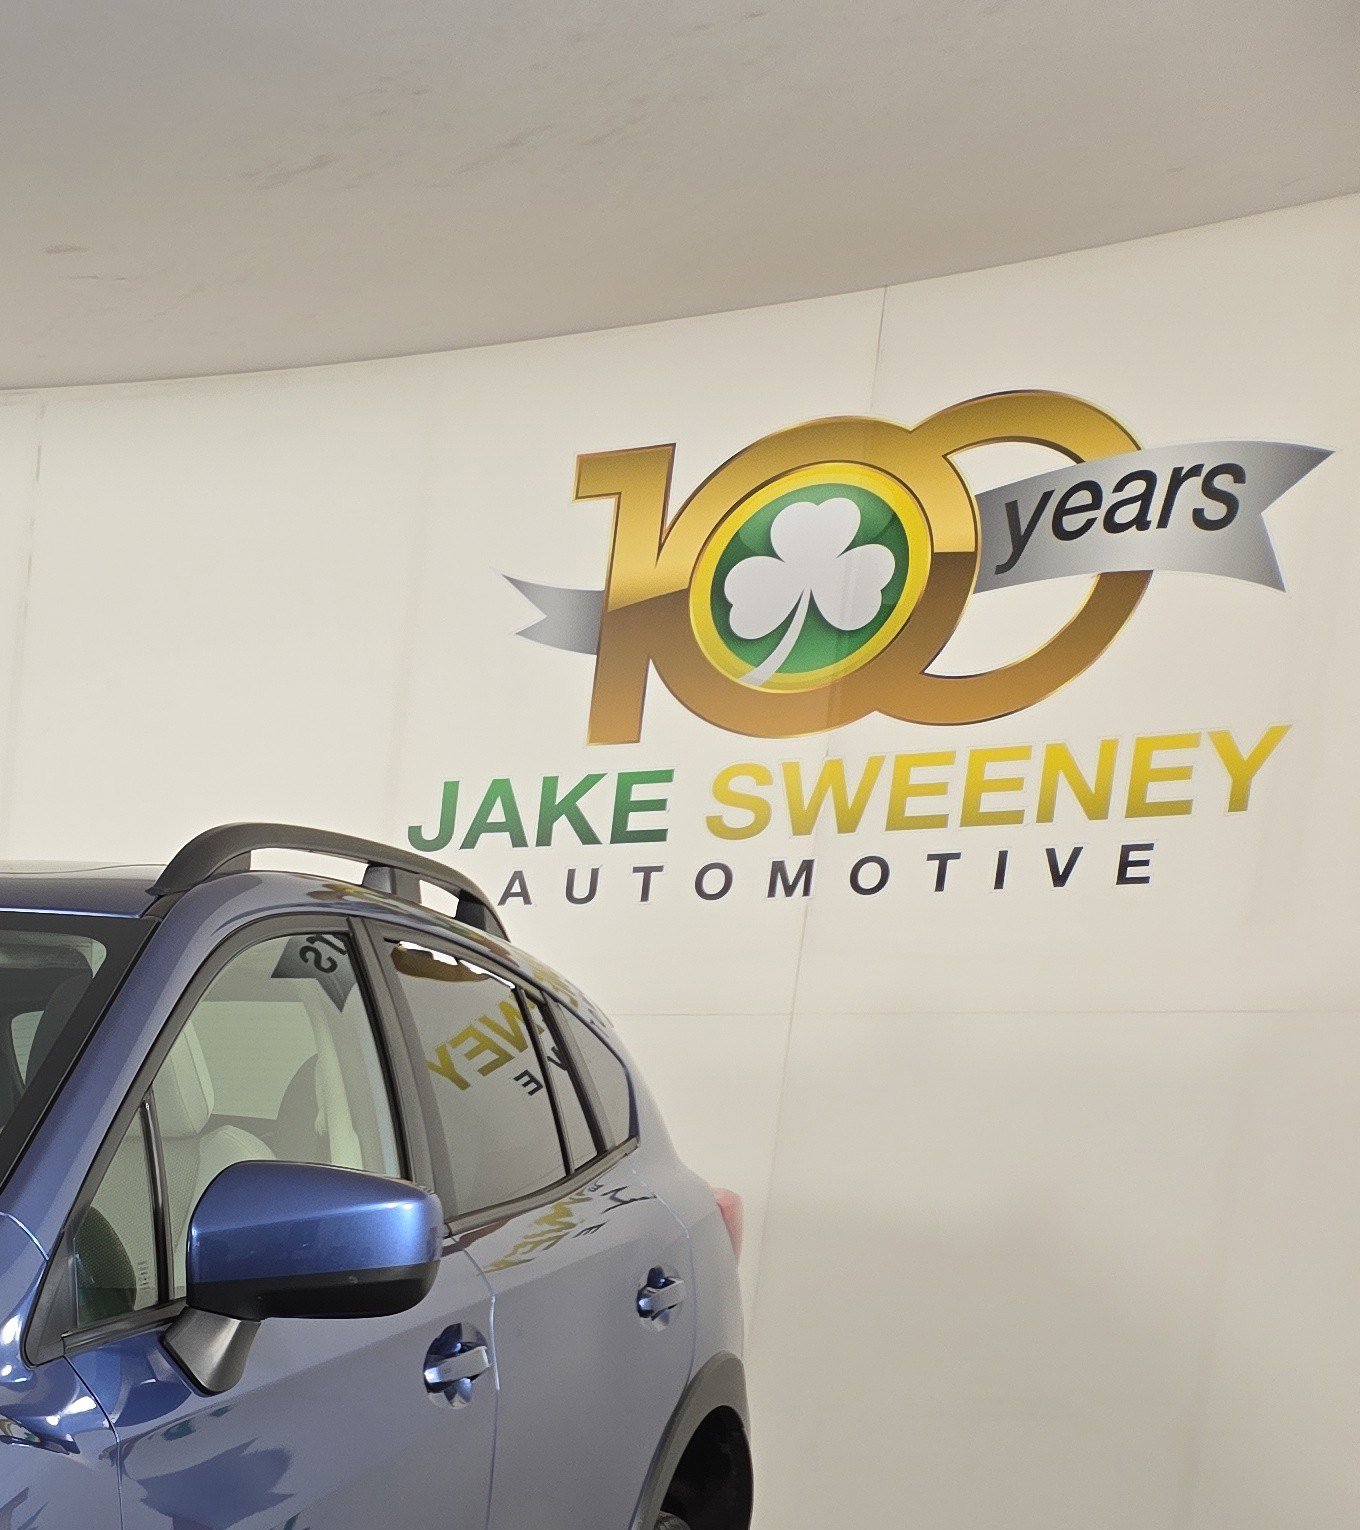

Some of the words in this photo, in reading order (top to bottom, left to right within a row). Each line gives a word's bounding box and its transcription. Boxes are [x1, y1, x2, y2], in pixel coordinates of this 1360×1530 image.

[573, 389, 1154, 745] 100
[994, 461, 1247, 576] years
[408, 768, 675, 853] JAKE
[704, 724, 1293, 842] SWEENEY
[498, 842, 1157, 907] AUTOMOTIVE
